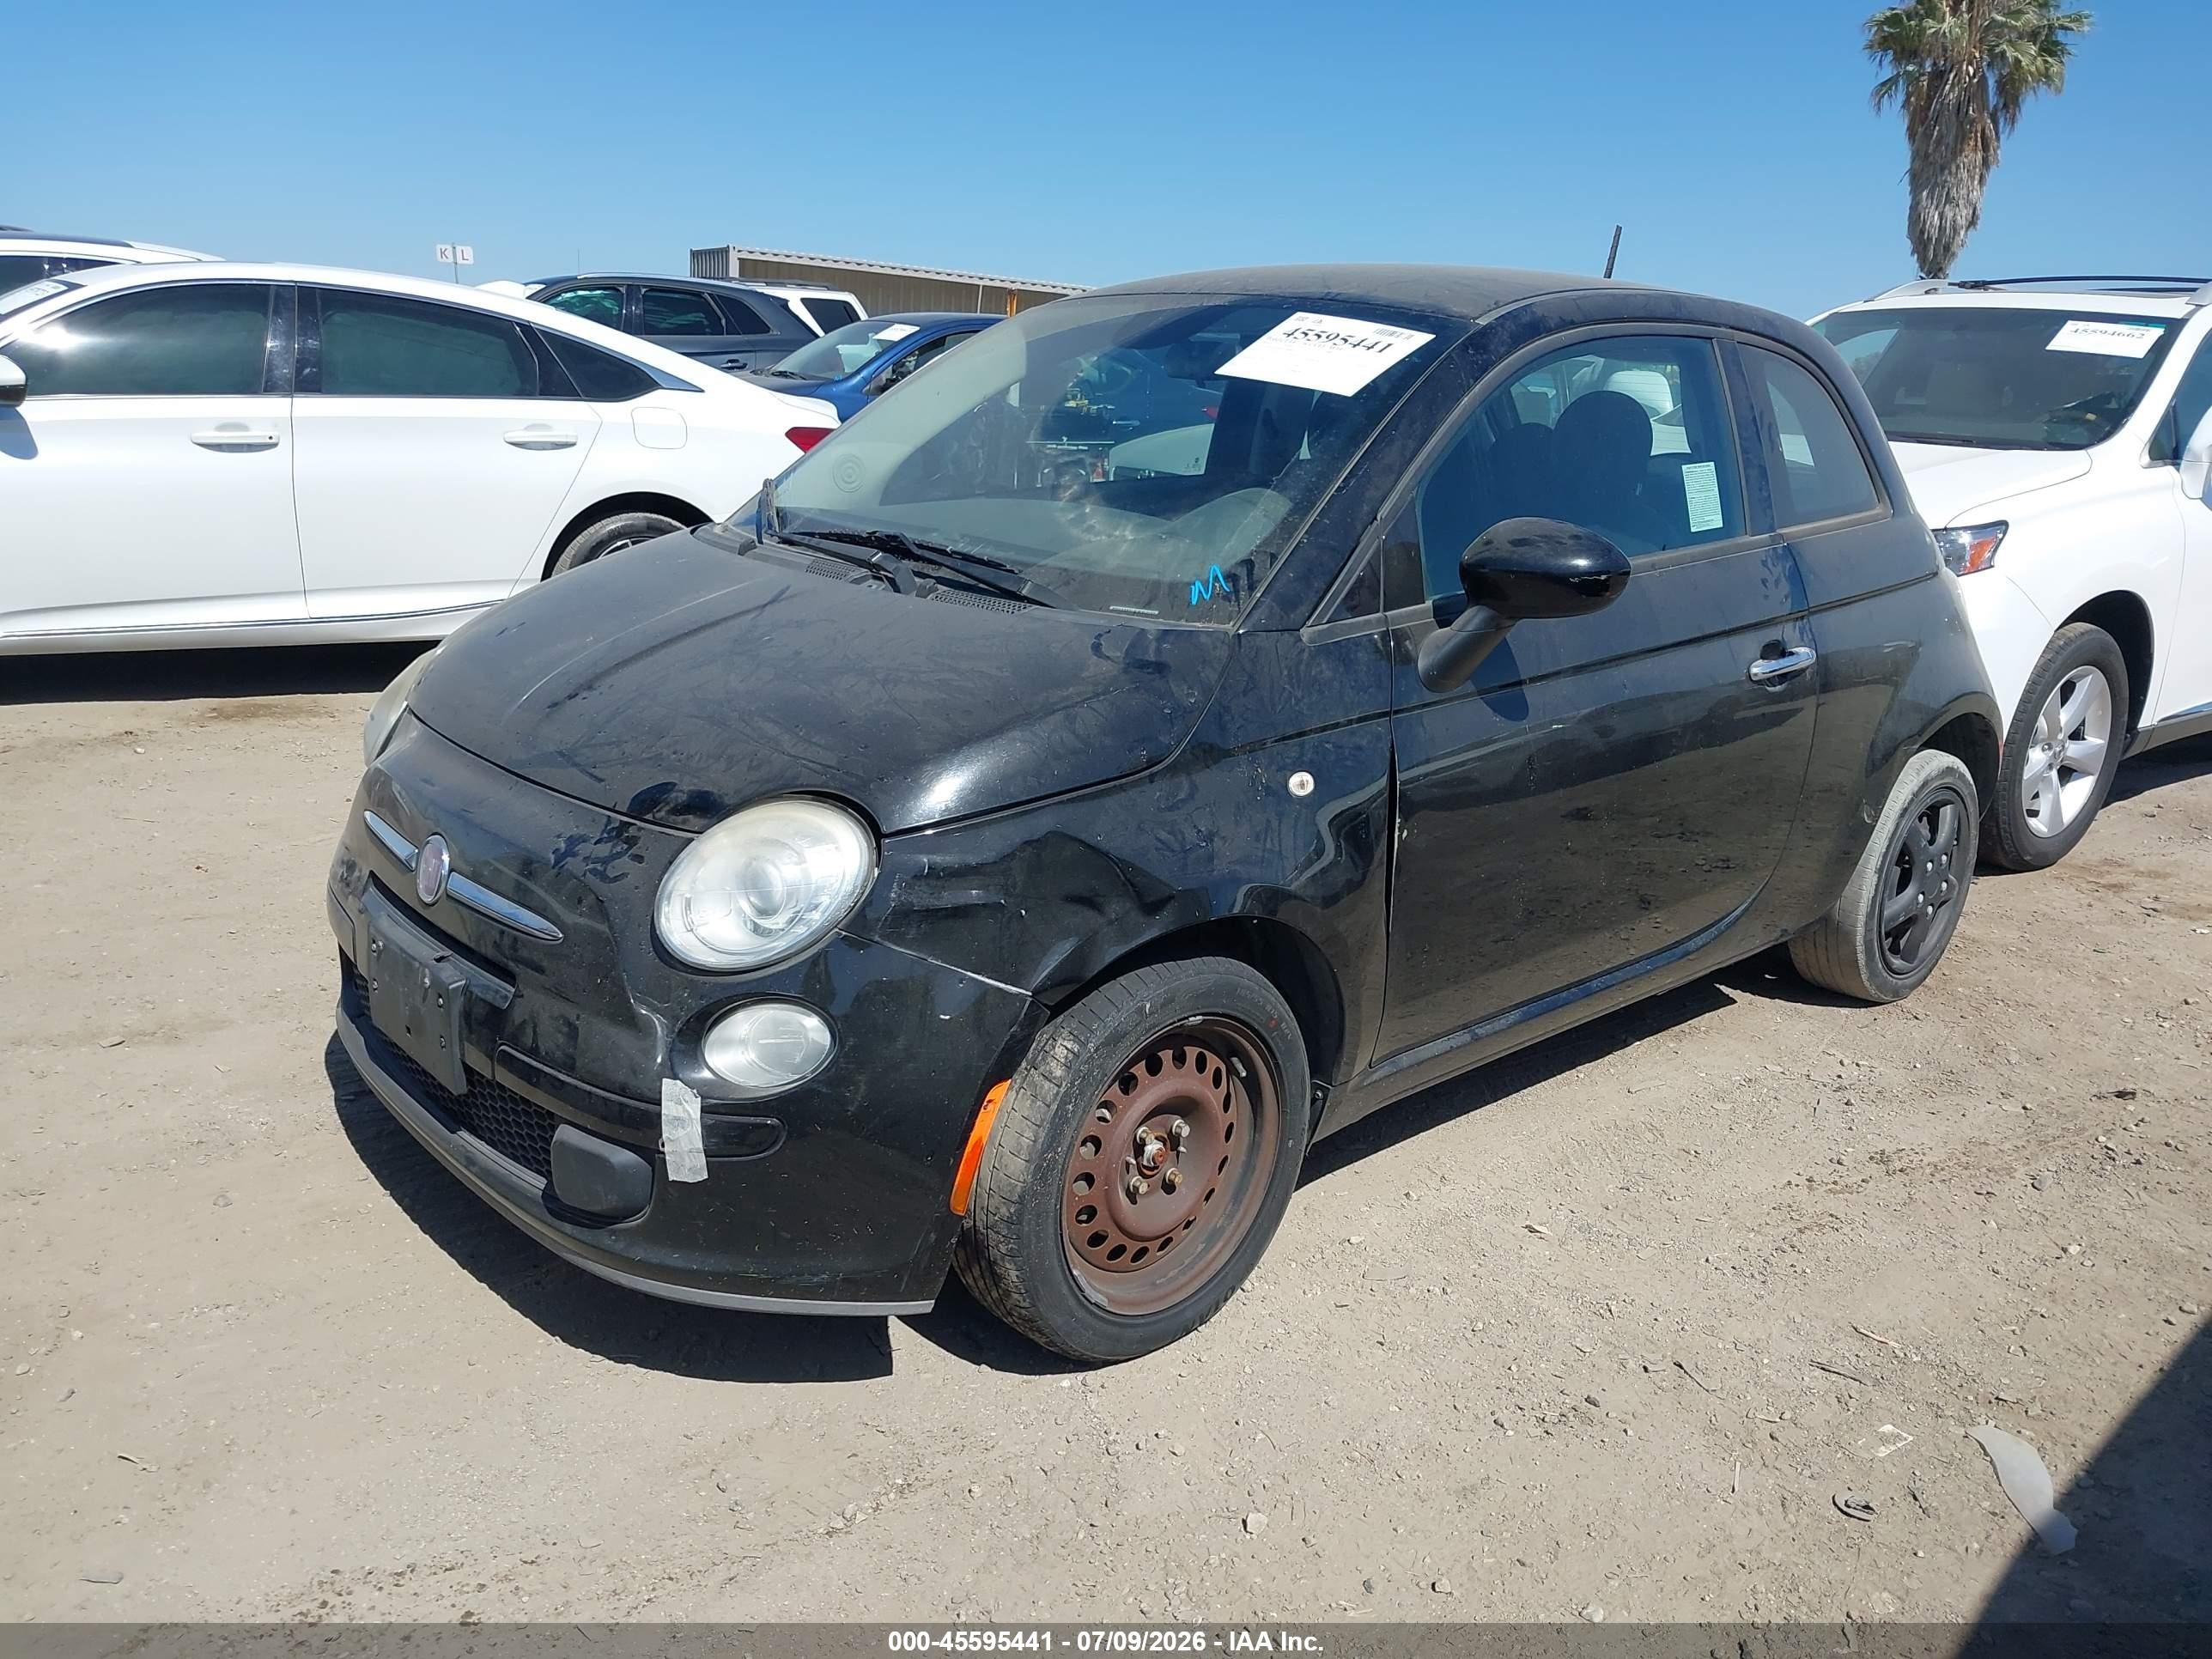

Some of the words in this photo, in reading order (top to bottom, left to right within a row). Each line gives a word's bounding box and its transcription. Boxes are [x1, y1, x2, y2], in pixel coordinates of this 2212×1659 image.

[439, 247, 449, 259] K
[460, 248, 470, 261] L
[1282, 326, 1395, 354] 45595441
